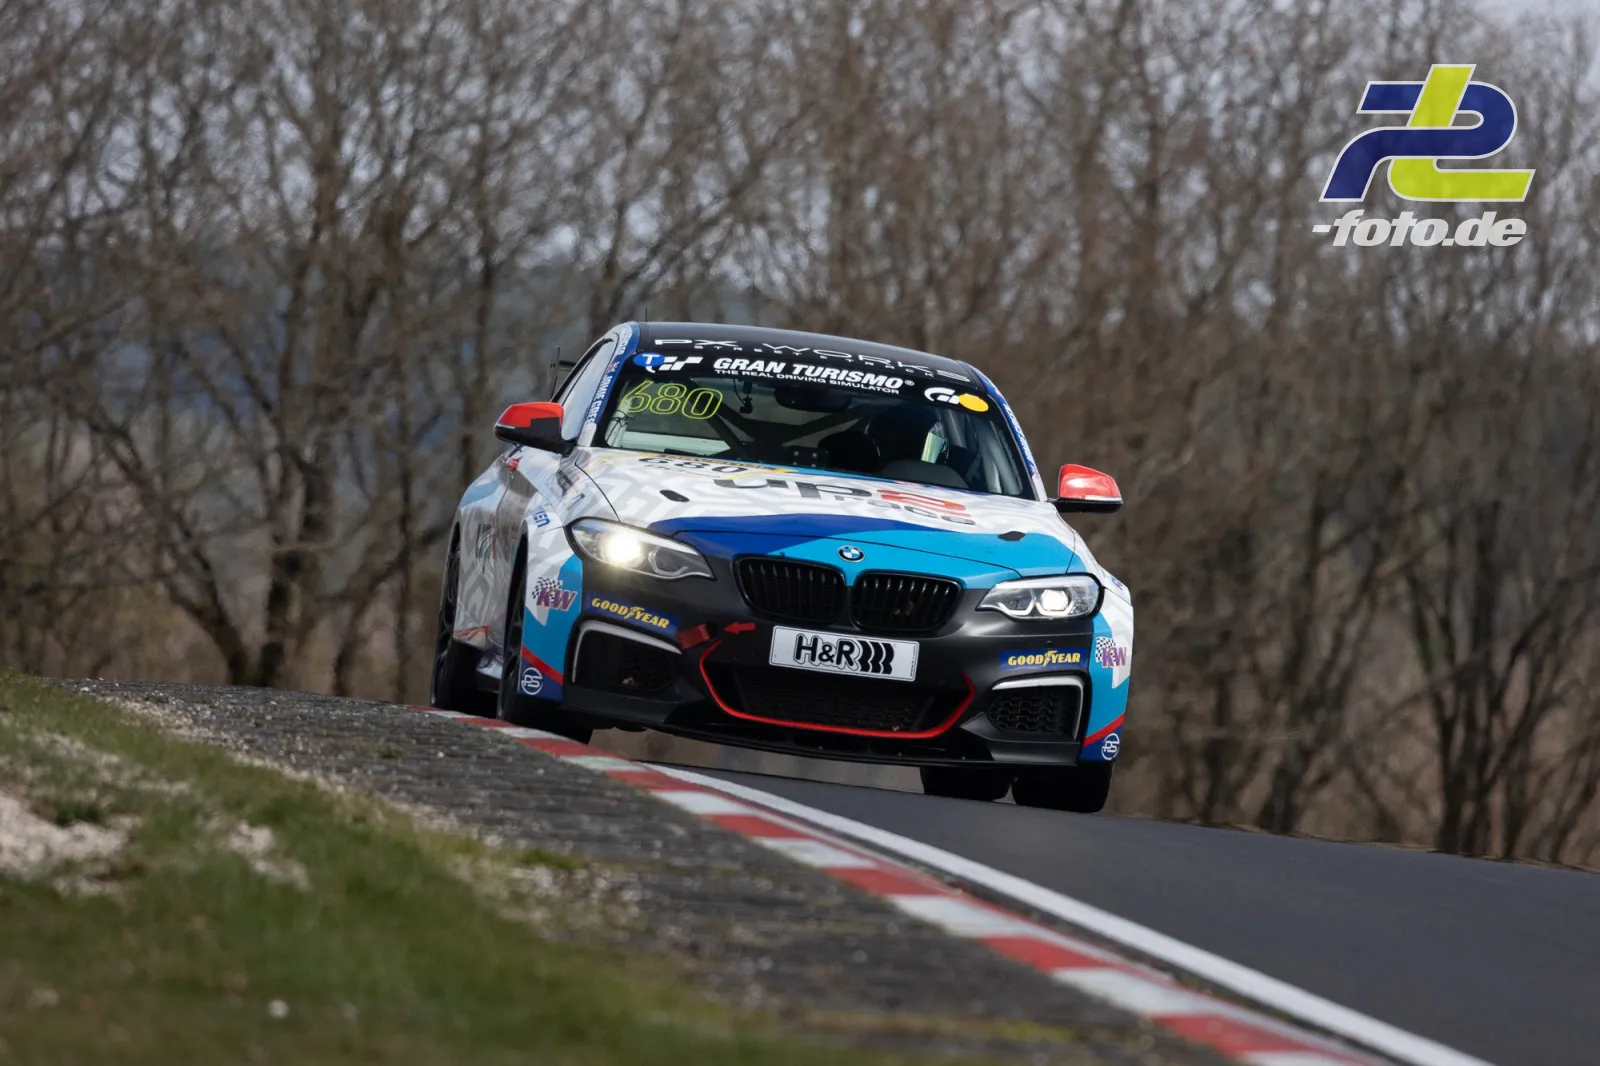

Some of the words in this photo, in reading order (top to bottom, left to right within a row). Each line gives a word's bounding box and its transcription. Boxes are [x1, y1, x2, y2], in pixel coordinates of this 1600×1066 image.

[713, 357, 786, 374] GRAN
[762, 343, 971, 383] WORKS
[776, 373, 827, 384] DRIVING
[829, 380, 900, 395] SIMULATOR
[619, 380, 723, 420] 680
[536, 586, 578, 612] KW
[591, 598, 670, 628] GOODYEAR
[794, 633, 860, 670] H&R
[1008, 650, 1081, 667] GOODYEAR
[1101, 646, 1127, 668] KW
